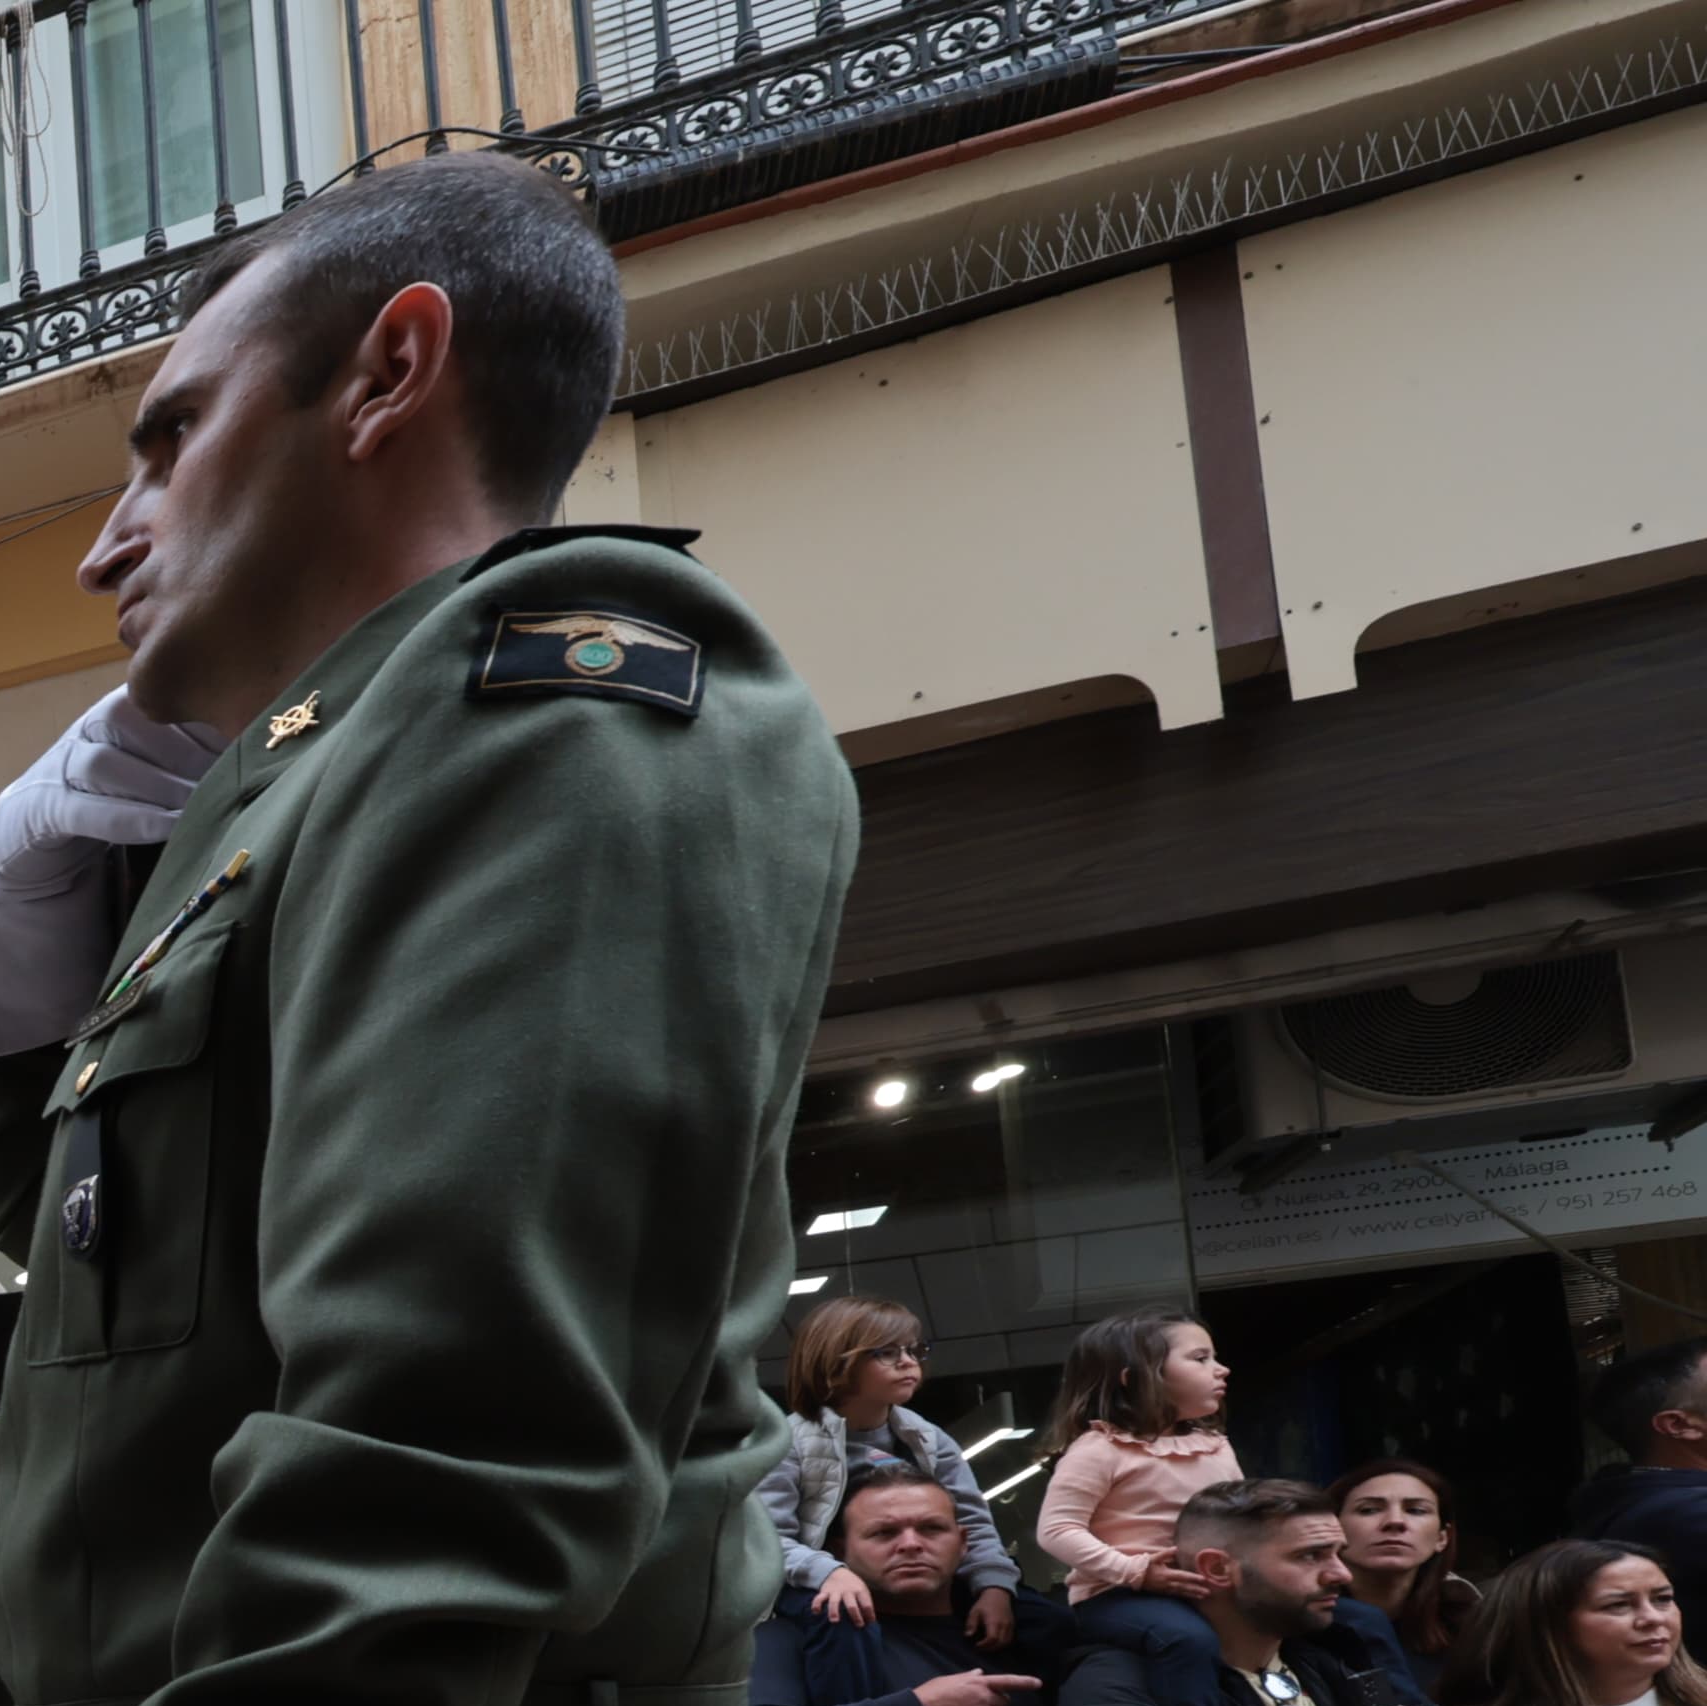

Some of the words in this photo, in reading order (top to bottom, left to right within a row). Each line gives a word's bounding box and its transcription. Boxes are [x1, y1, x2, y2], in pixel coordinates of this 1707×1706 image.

[1485, 1158, 1570, 1181] Málaga
[1556, 1194, 1593, 1212] 951
[1602, 1187, 1643, 1207] 257
[1650, 1180, 1698, 1199] 468
